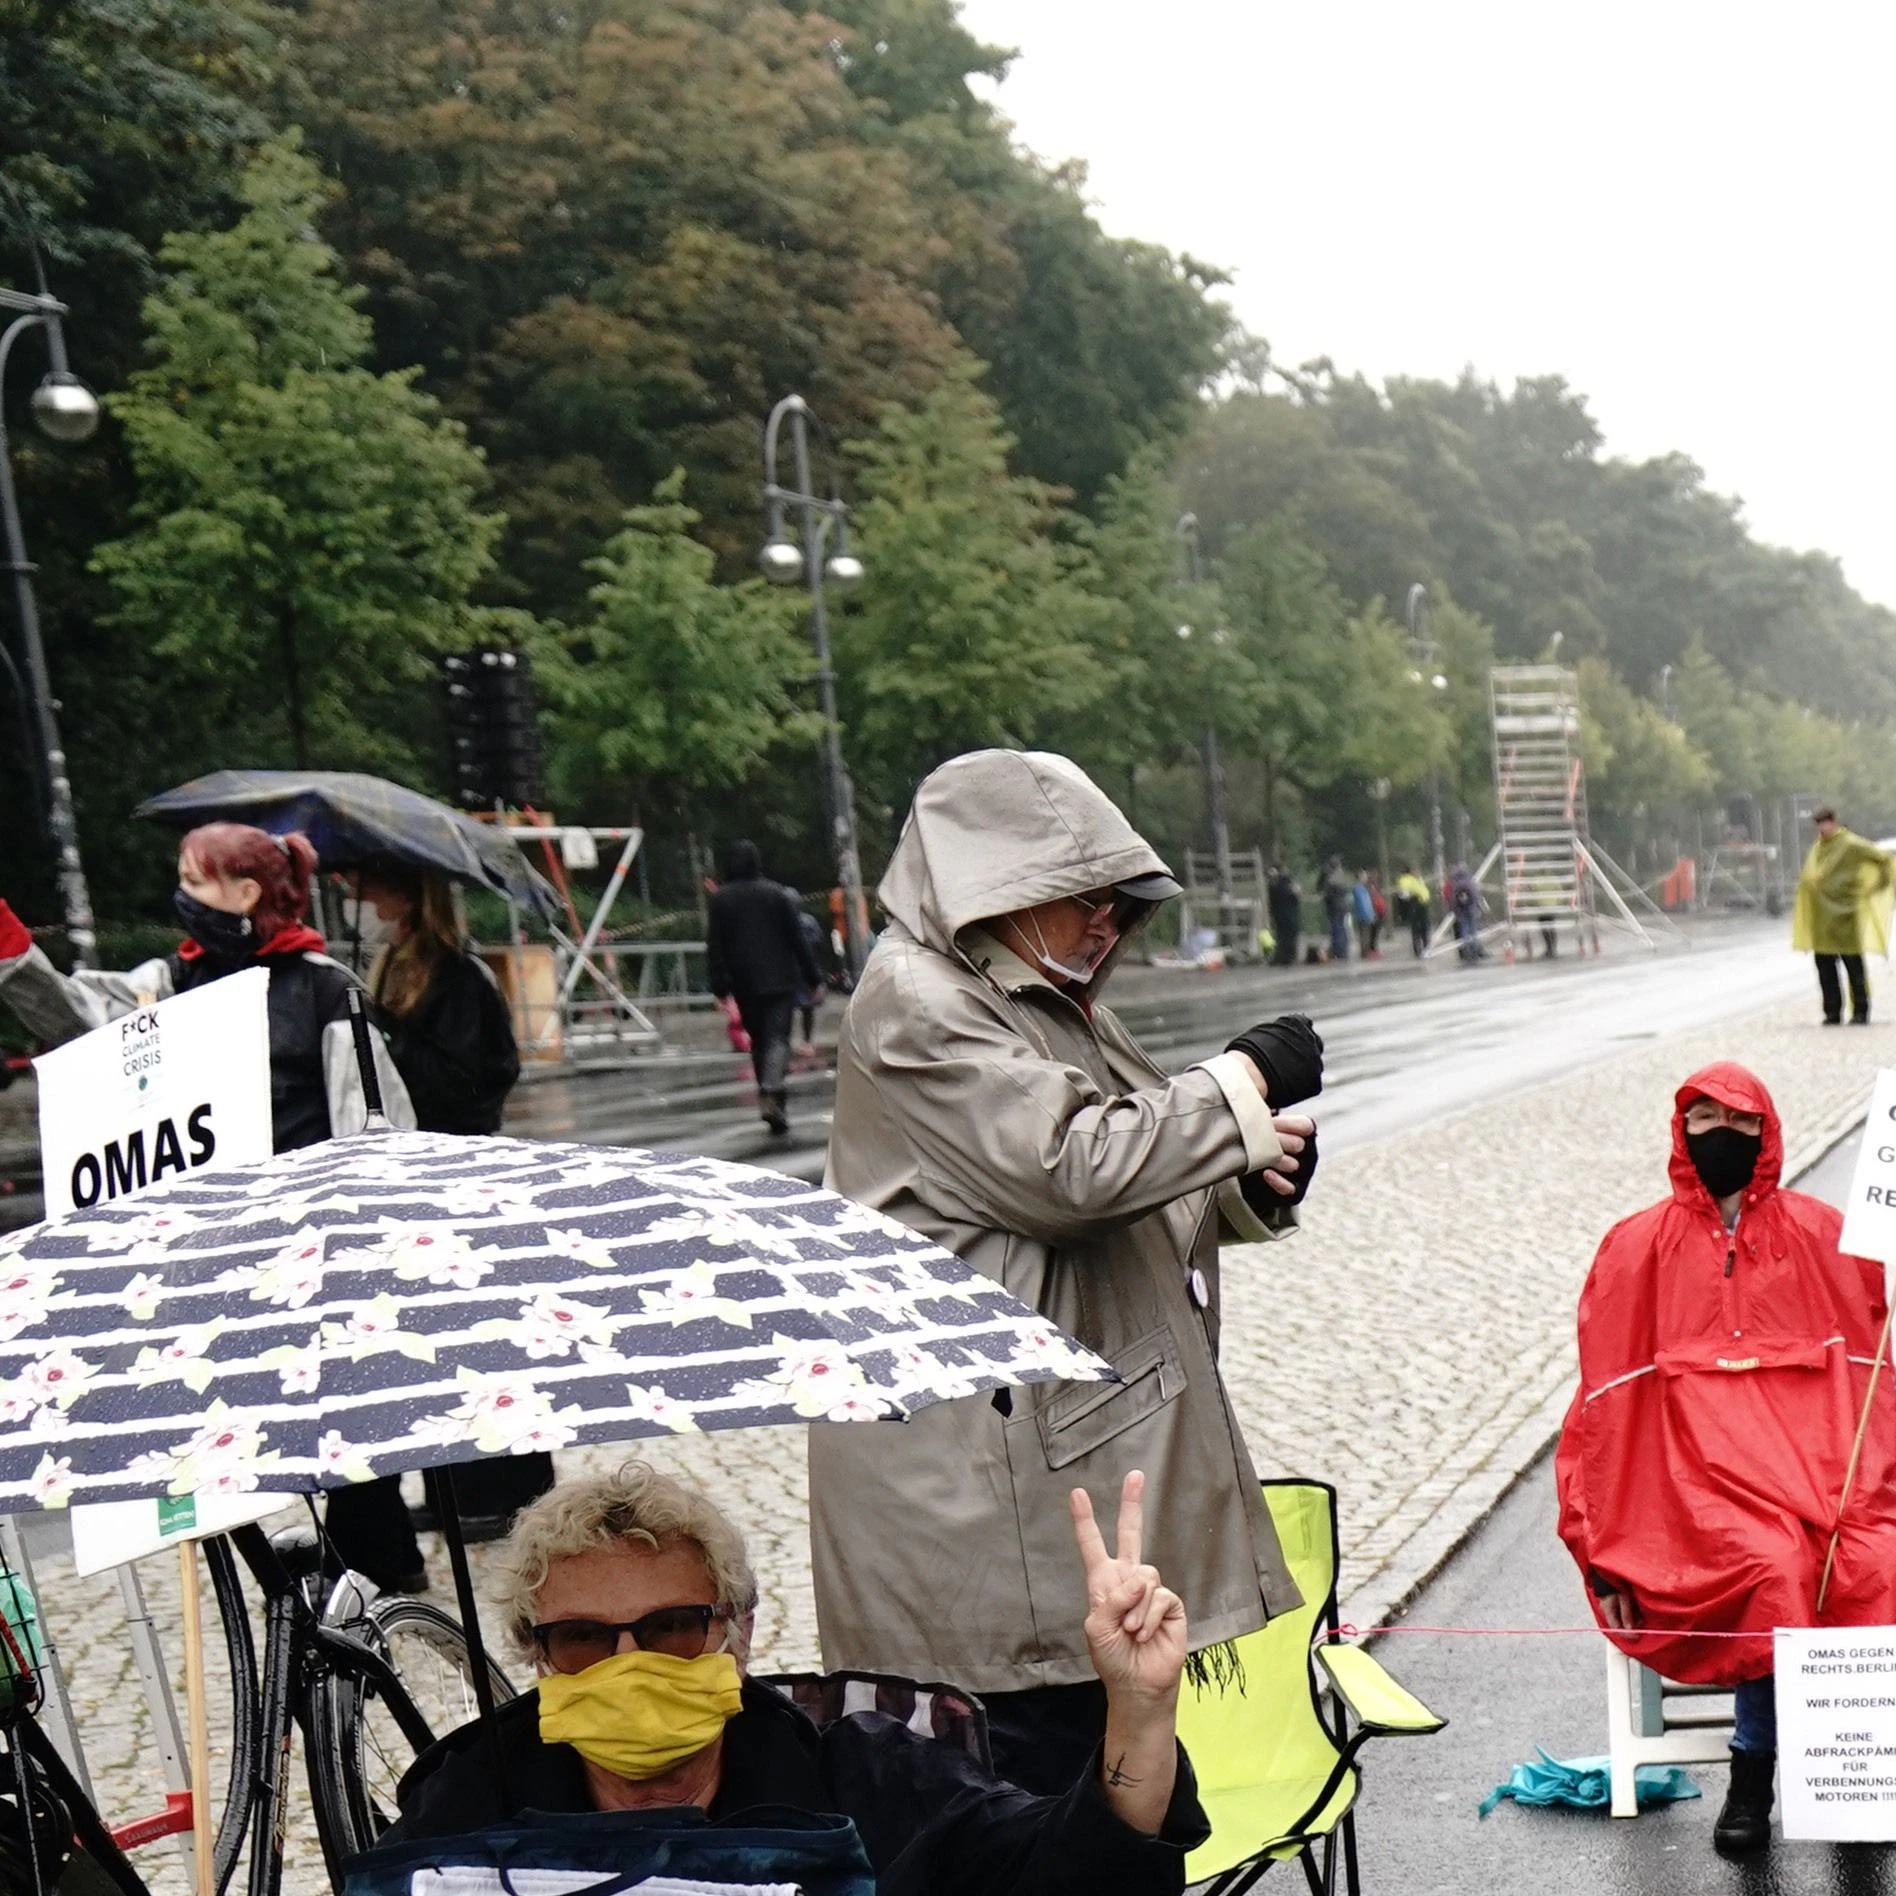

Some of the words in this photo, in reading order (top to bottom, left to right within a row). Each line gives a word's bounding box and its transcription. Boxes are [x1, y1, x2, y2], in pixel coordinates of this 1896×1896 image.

[122, 1033, 160, 1057] CLIMATE
[124, 1050, 161, 1076] CRISIS
[72, 1103, 215, 1209] OMAS
[1808, 1650, 1846, 1660] OMAS
[1850, 1648, 1894, 1658] GEGEN
[1806, 1699, 1830, 1708] WIR
[1835, 1732, 1873, 1742] KEINE
[1842, 1760, 1868, 1772] FÜR
[1815, 1792, 1878, 1802] MOTOREN
